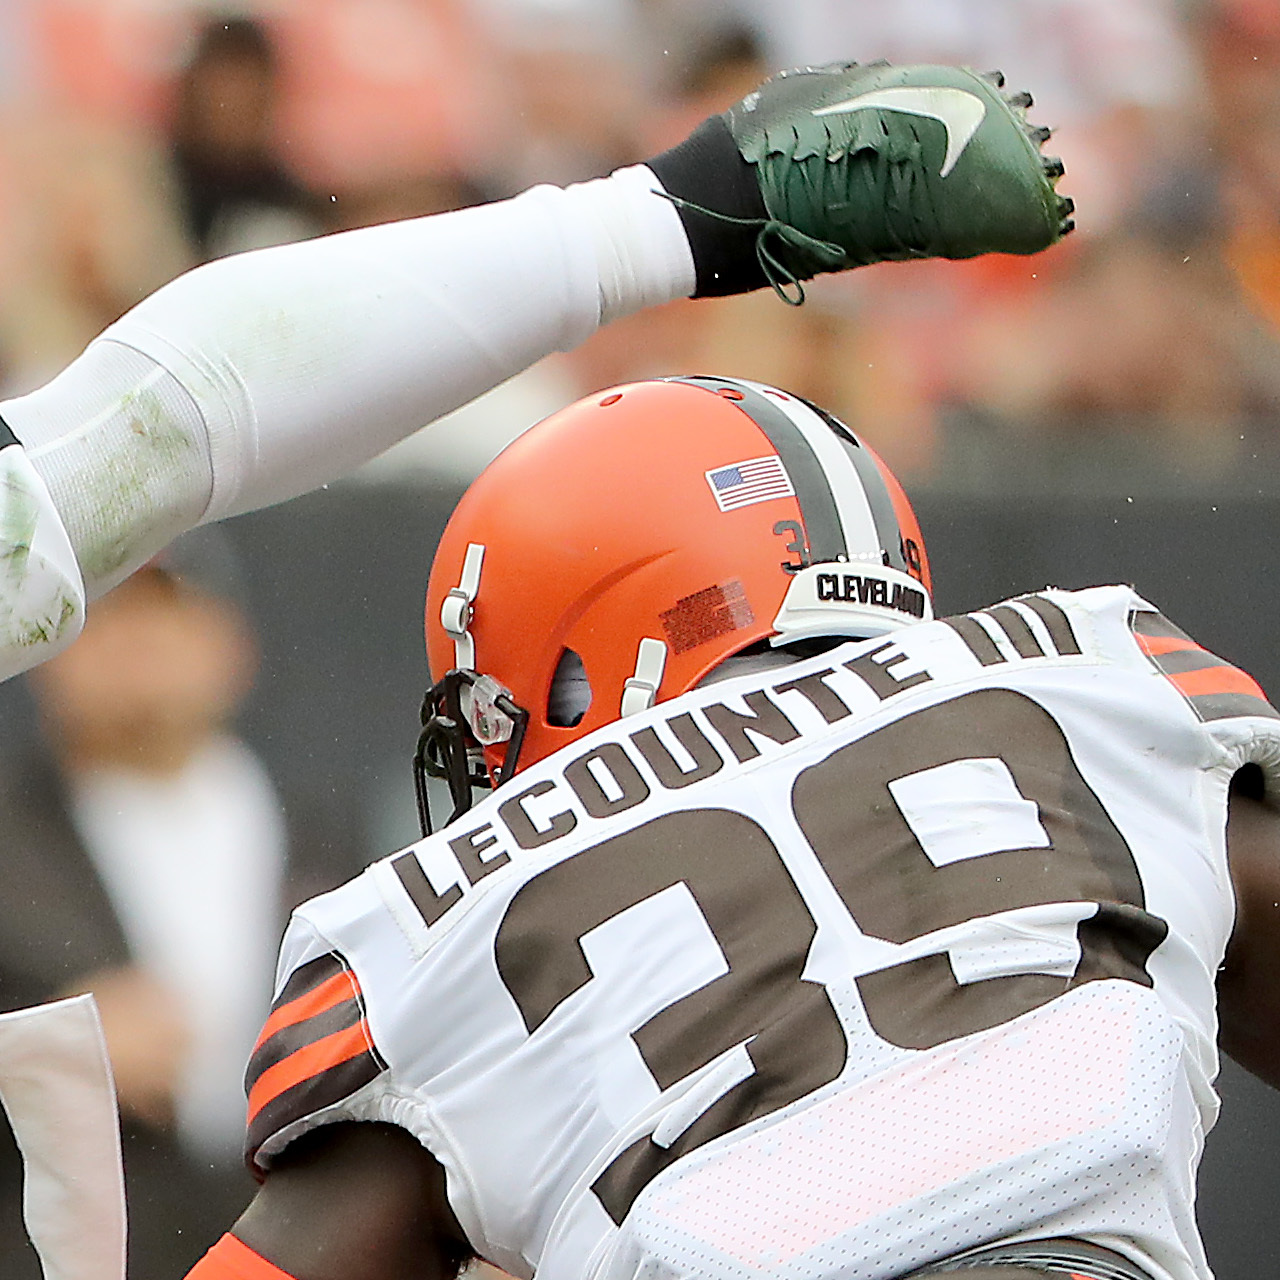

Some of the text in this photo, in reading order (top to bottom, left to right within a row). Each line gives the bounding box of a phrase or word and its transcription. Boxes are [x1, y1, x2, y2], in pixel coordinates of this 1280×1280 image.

[773, 520, 811, 575] 3
[817, 573, 925, 619] CLEVELAND
[940, 595, 1083, 666] III
[494, 688, 1169, 1227] 39
